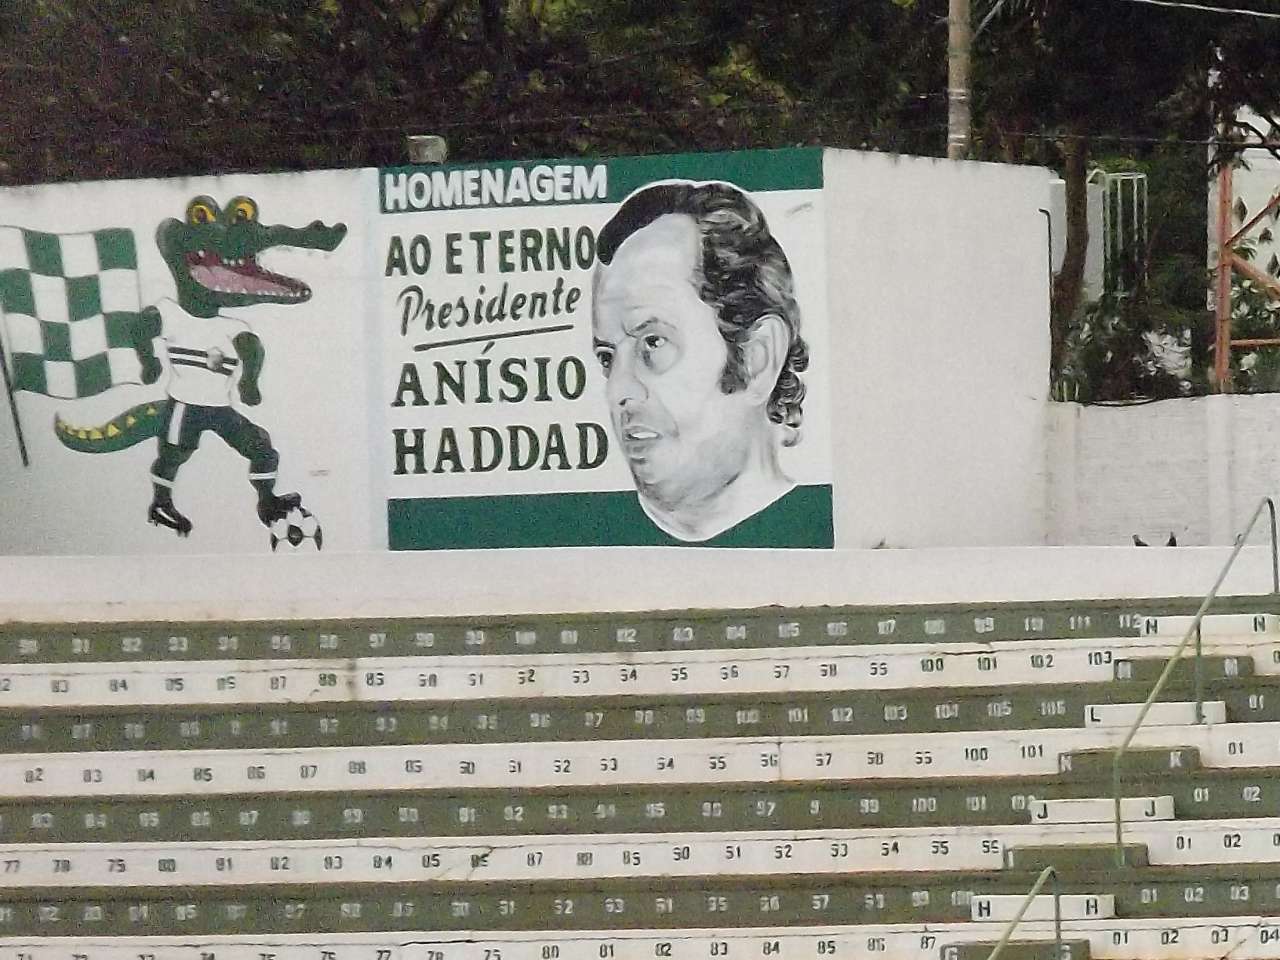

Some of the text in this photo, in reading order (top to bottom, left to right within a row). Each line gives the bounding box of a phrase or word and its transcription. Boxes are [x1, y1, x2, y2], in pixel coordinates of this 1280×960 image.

[384, 164, 608, 210] HOMENAGEM
[385, 225, 597, 276] AO ETERNO
[398, 277, 582, 336] Presidente
[391, 342, 587, 407] ANÍSIO
[392, 421, 609, 475] HADDAD
[1145, 615, 1266, 635] N N
[920, 650, 1113, 673] 100 101 102 103
[1089, 707, 1103, 722] L
[1227, 741, 1244, 756] 01
[1036, 799, 1157, 820] J J
[1176, 835, 1192, 851] 01
[1223, 833, 1242, 849] 02
[976, 898, 1099, 918] H H
[1112, 928, 1130, 946] 01
[1160, 928, 1180, 946] 02
[1210, 927, 1230, 944] 03
[1259, 928, 1280, 945] 04
